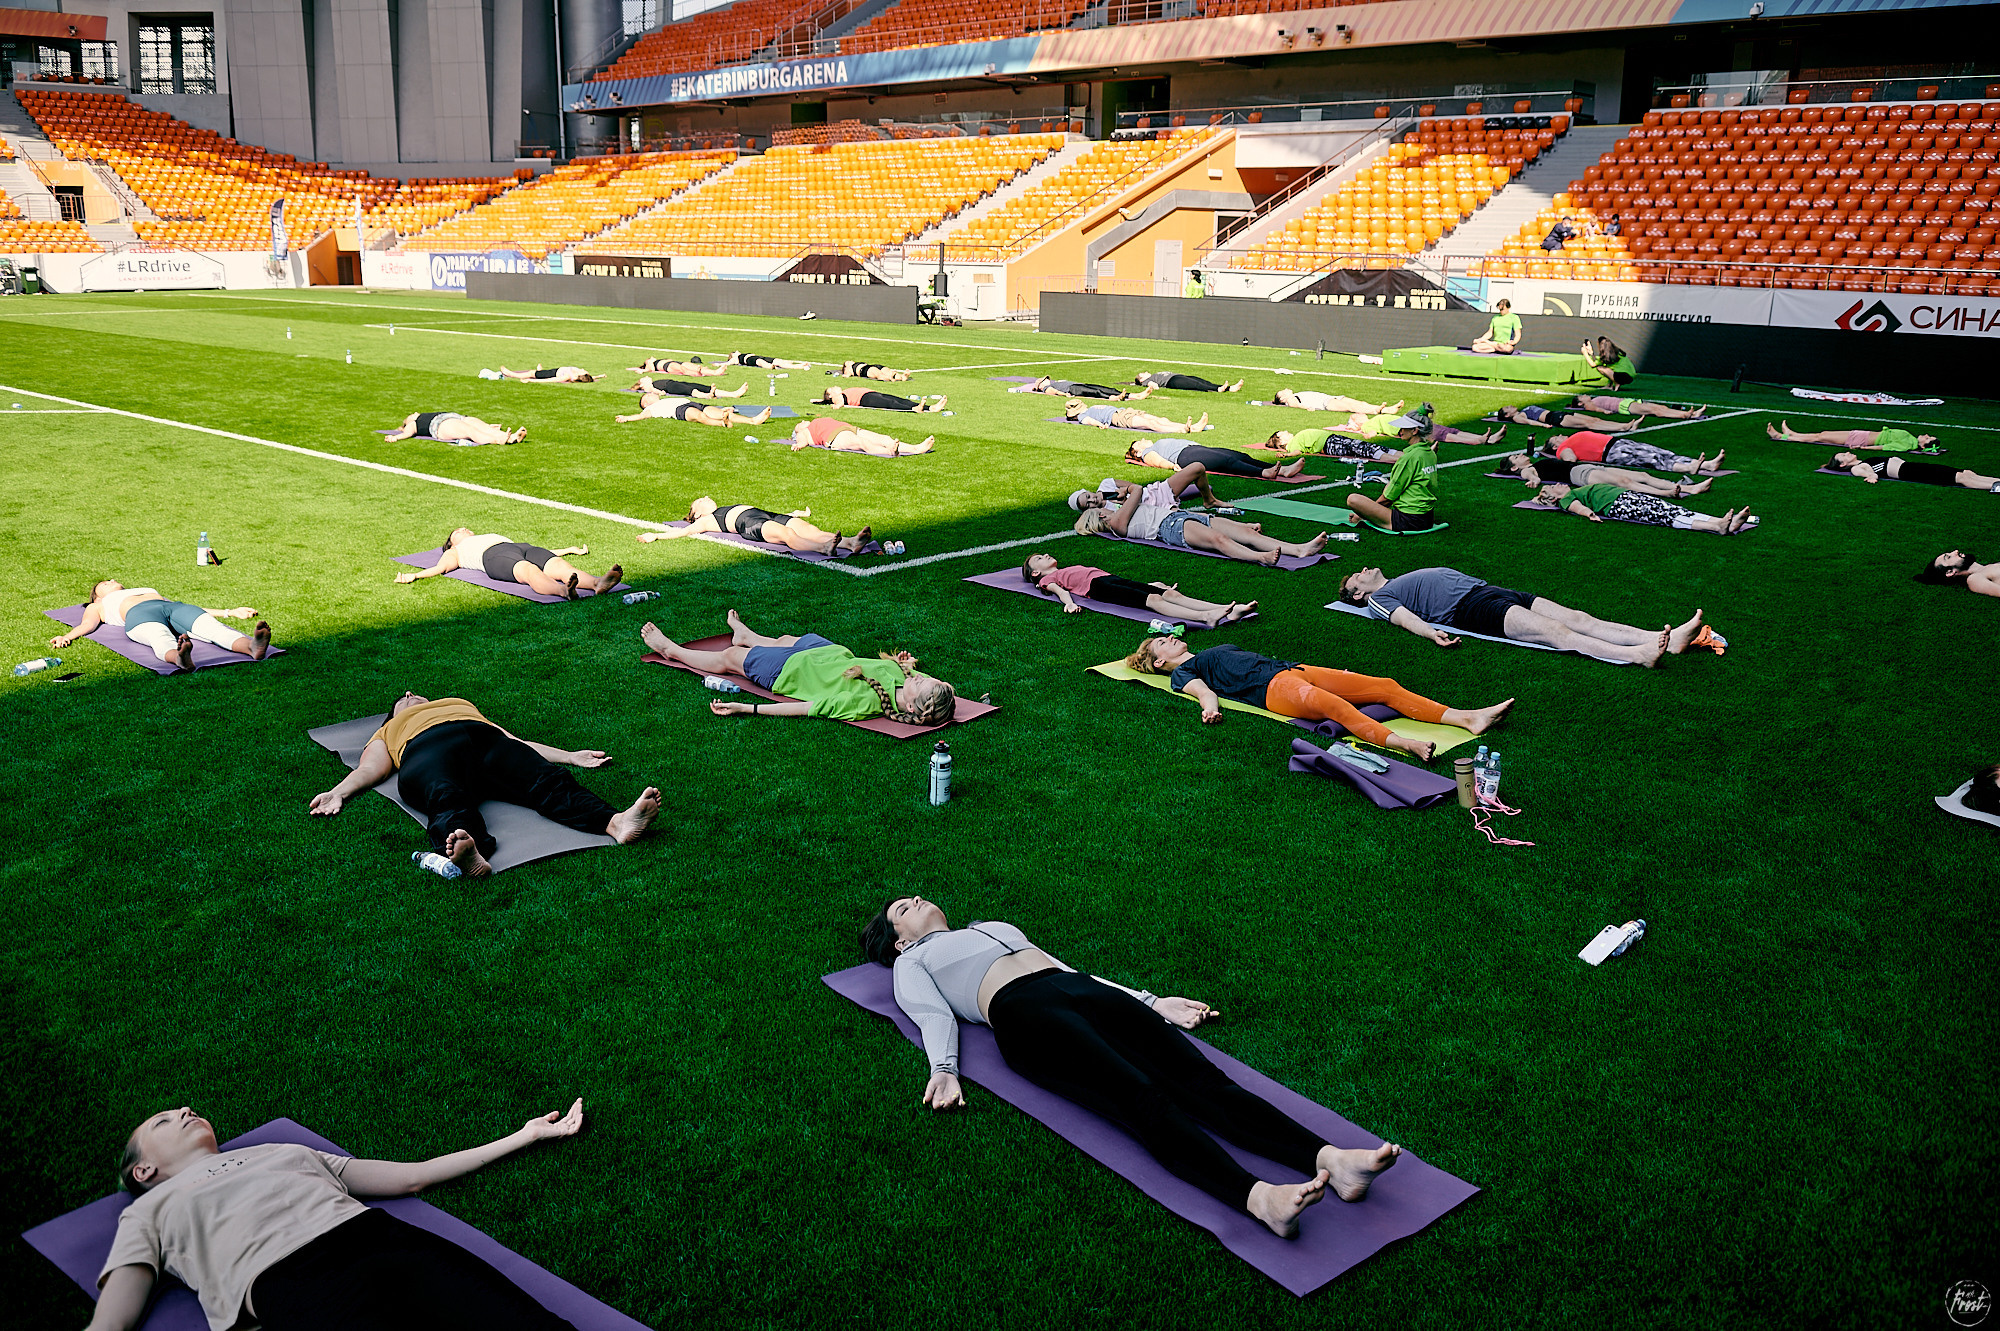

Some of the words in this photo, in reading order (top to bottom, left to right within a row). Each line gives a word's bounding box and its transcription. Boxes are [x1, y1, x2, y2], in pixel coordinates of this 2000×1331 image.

[671, 61, 848, 97] #EKATERINBURGARENA
[117, 260, 191, 273] #LRdrive
[1587, 294, 1639, 307] ТРУБНАЯ
